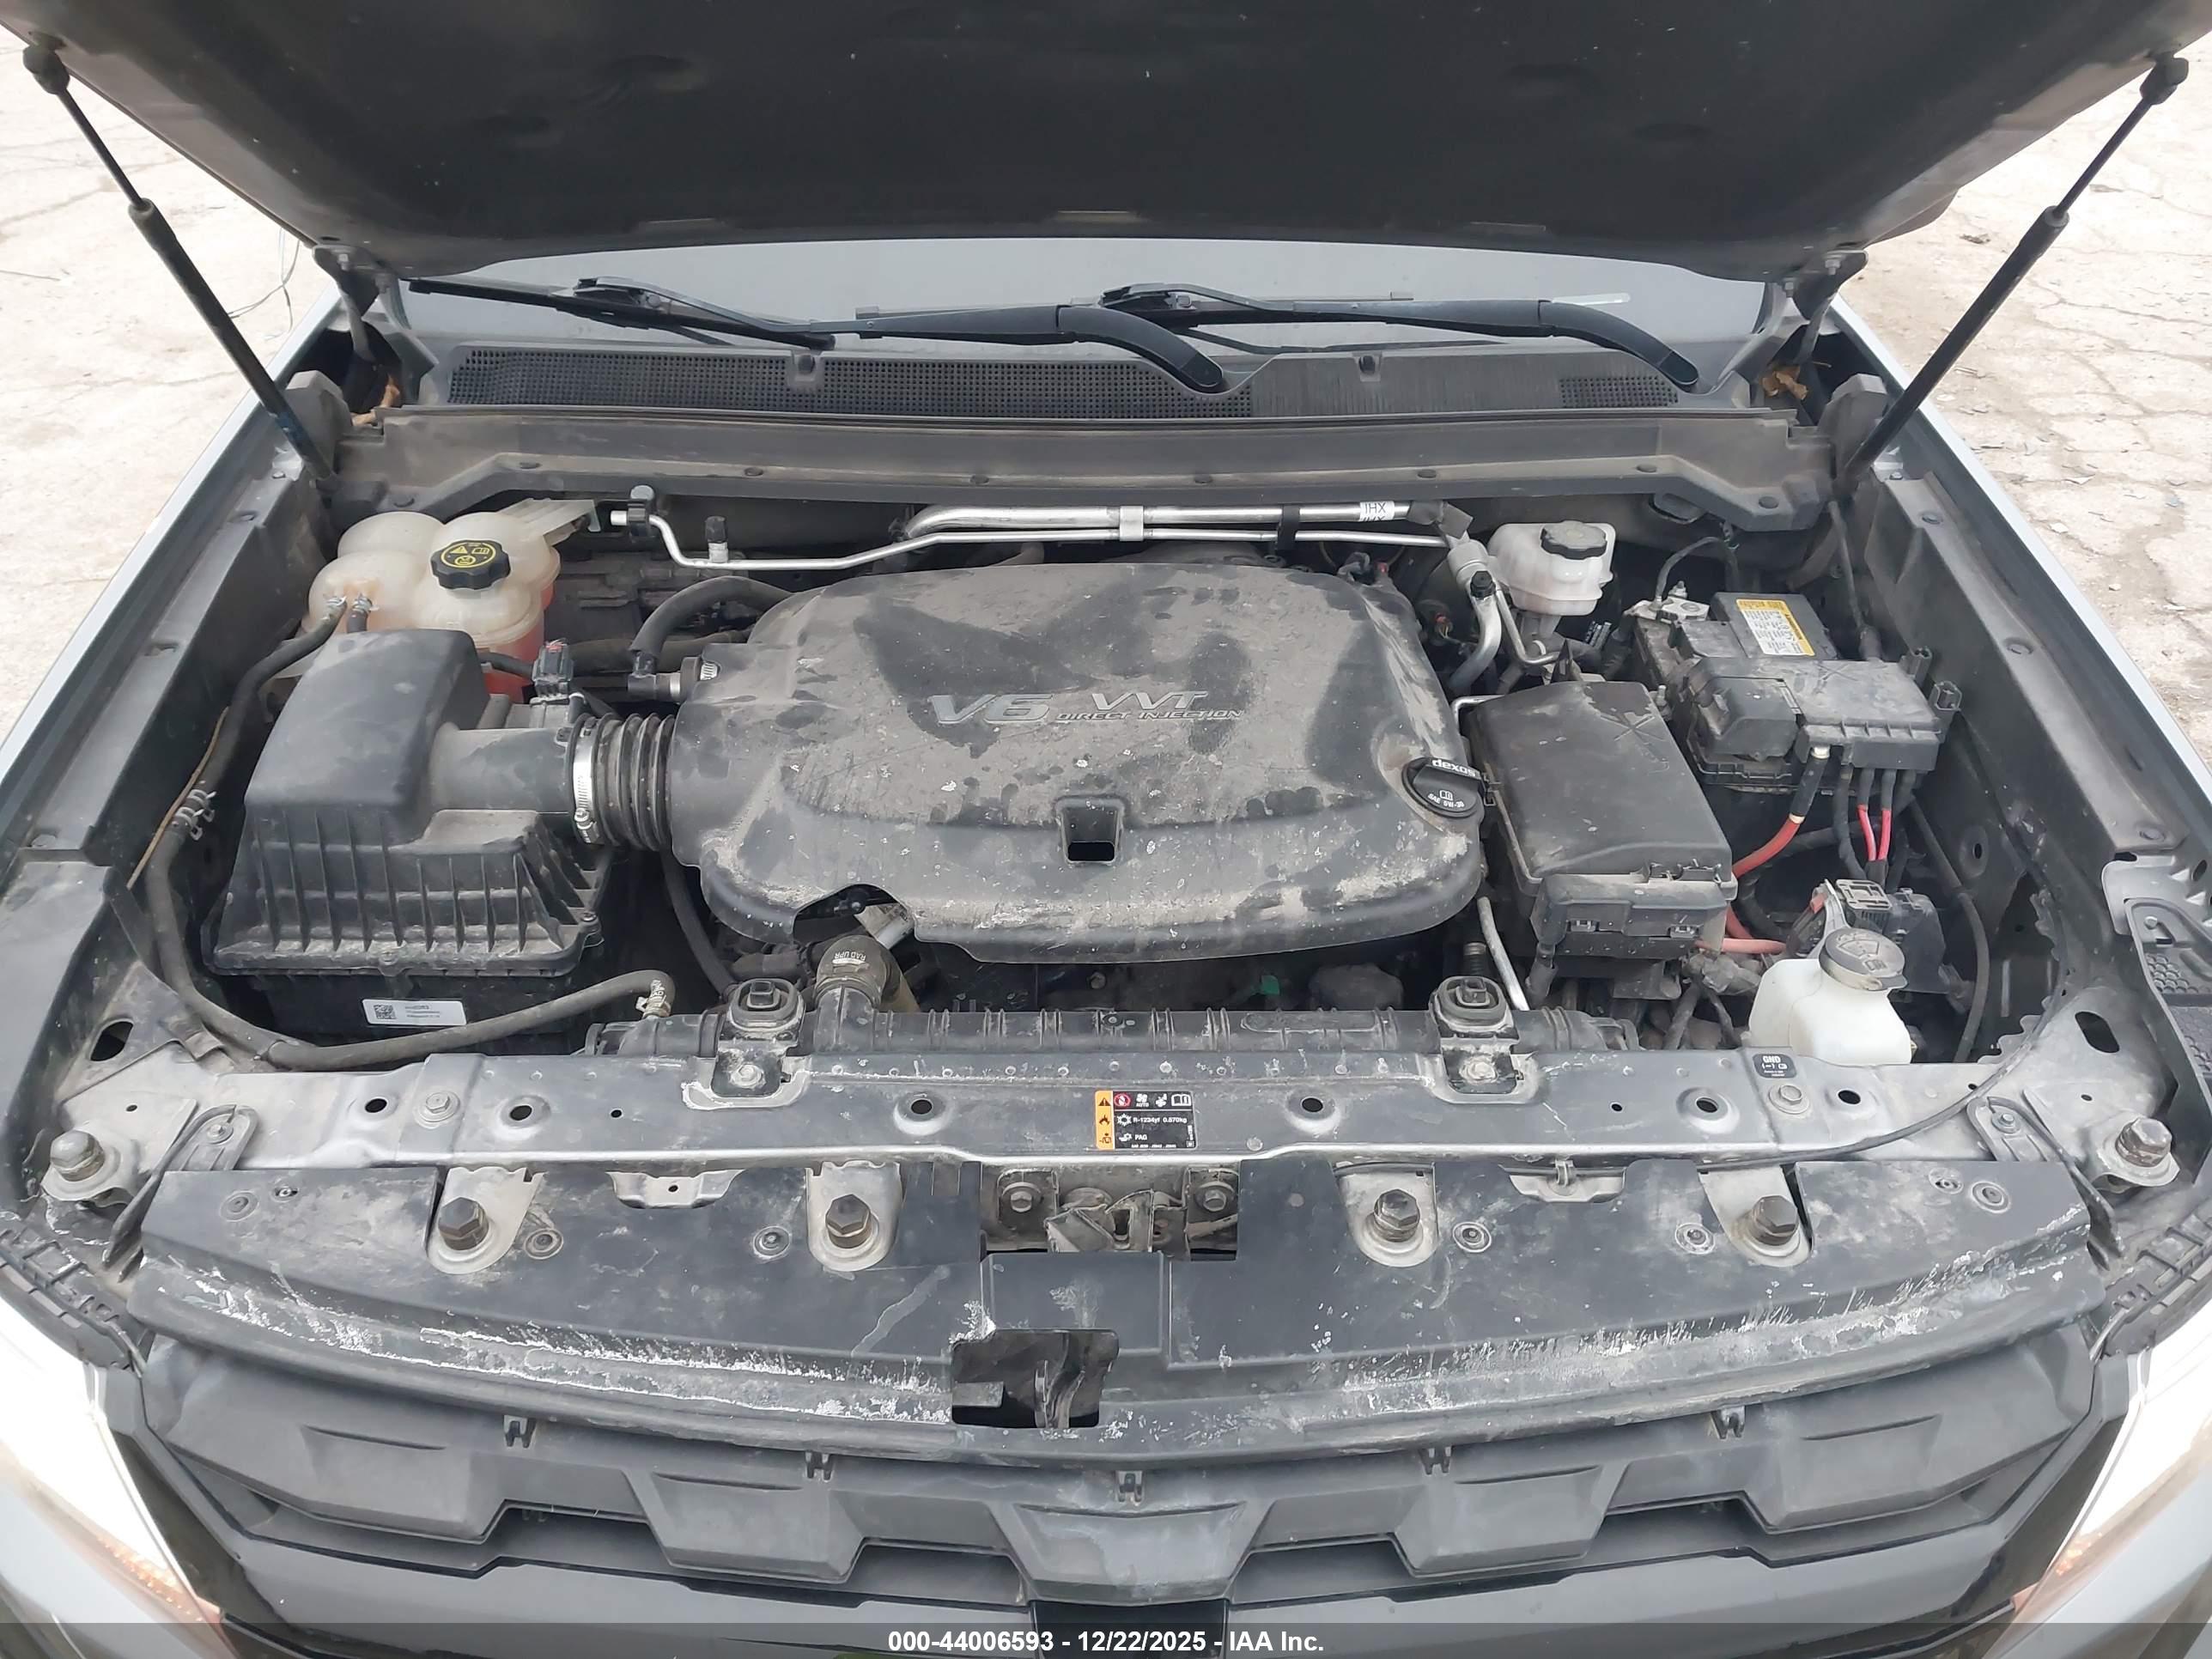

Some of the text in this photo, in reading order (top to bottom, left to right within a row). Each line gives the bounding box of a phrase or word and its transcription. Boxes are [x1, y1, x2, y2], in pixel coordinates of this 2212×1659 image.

[927, 693, 1053, 725] V6
[1091, 690, 1208, 711] VVT
[1055, 709, 1243, 722] DIRECT INJECTION
[1427, 793, 1441, 805] SAE
